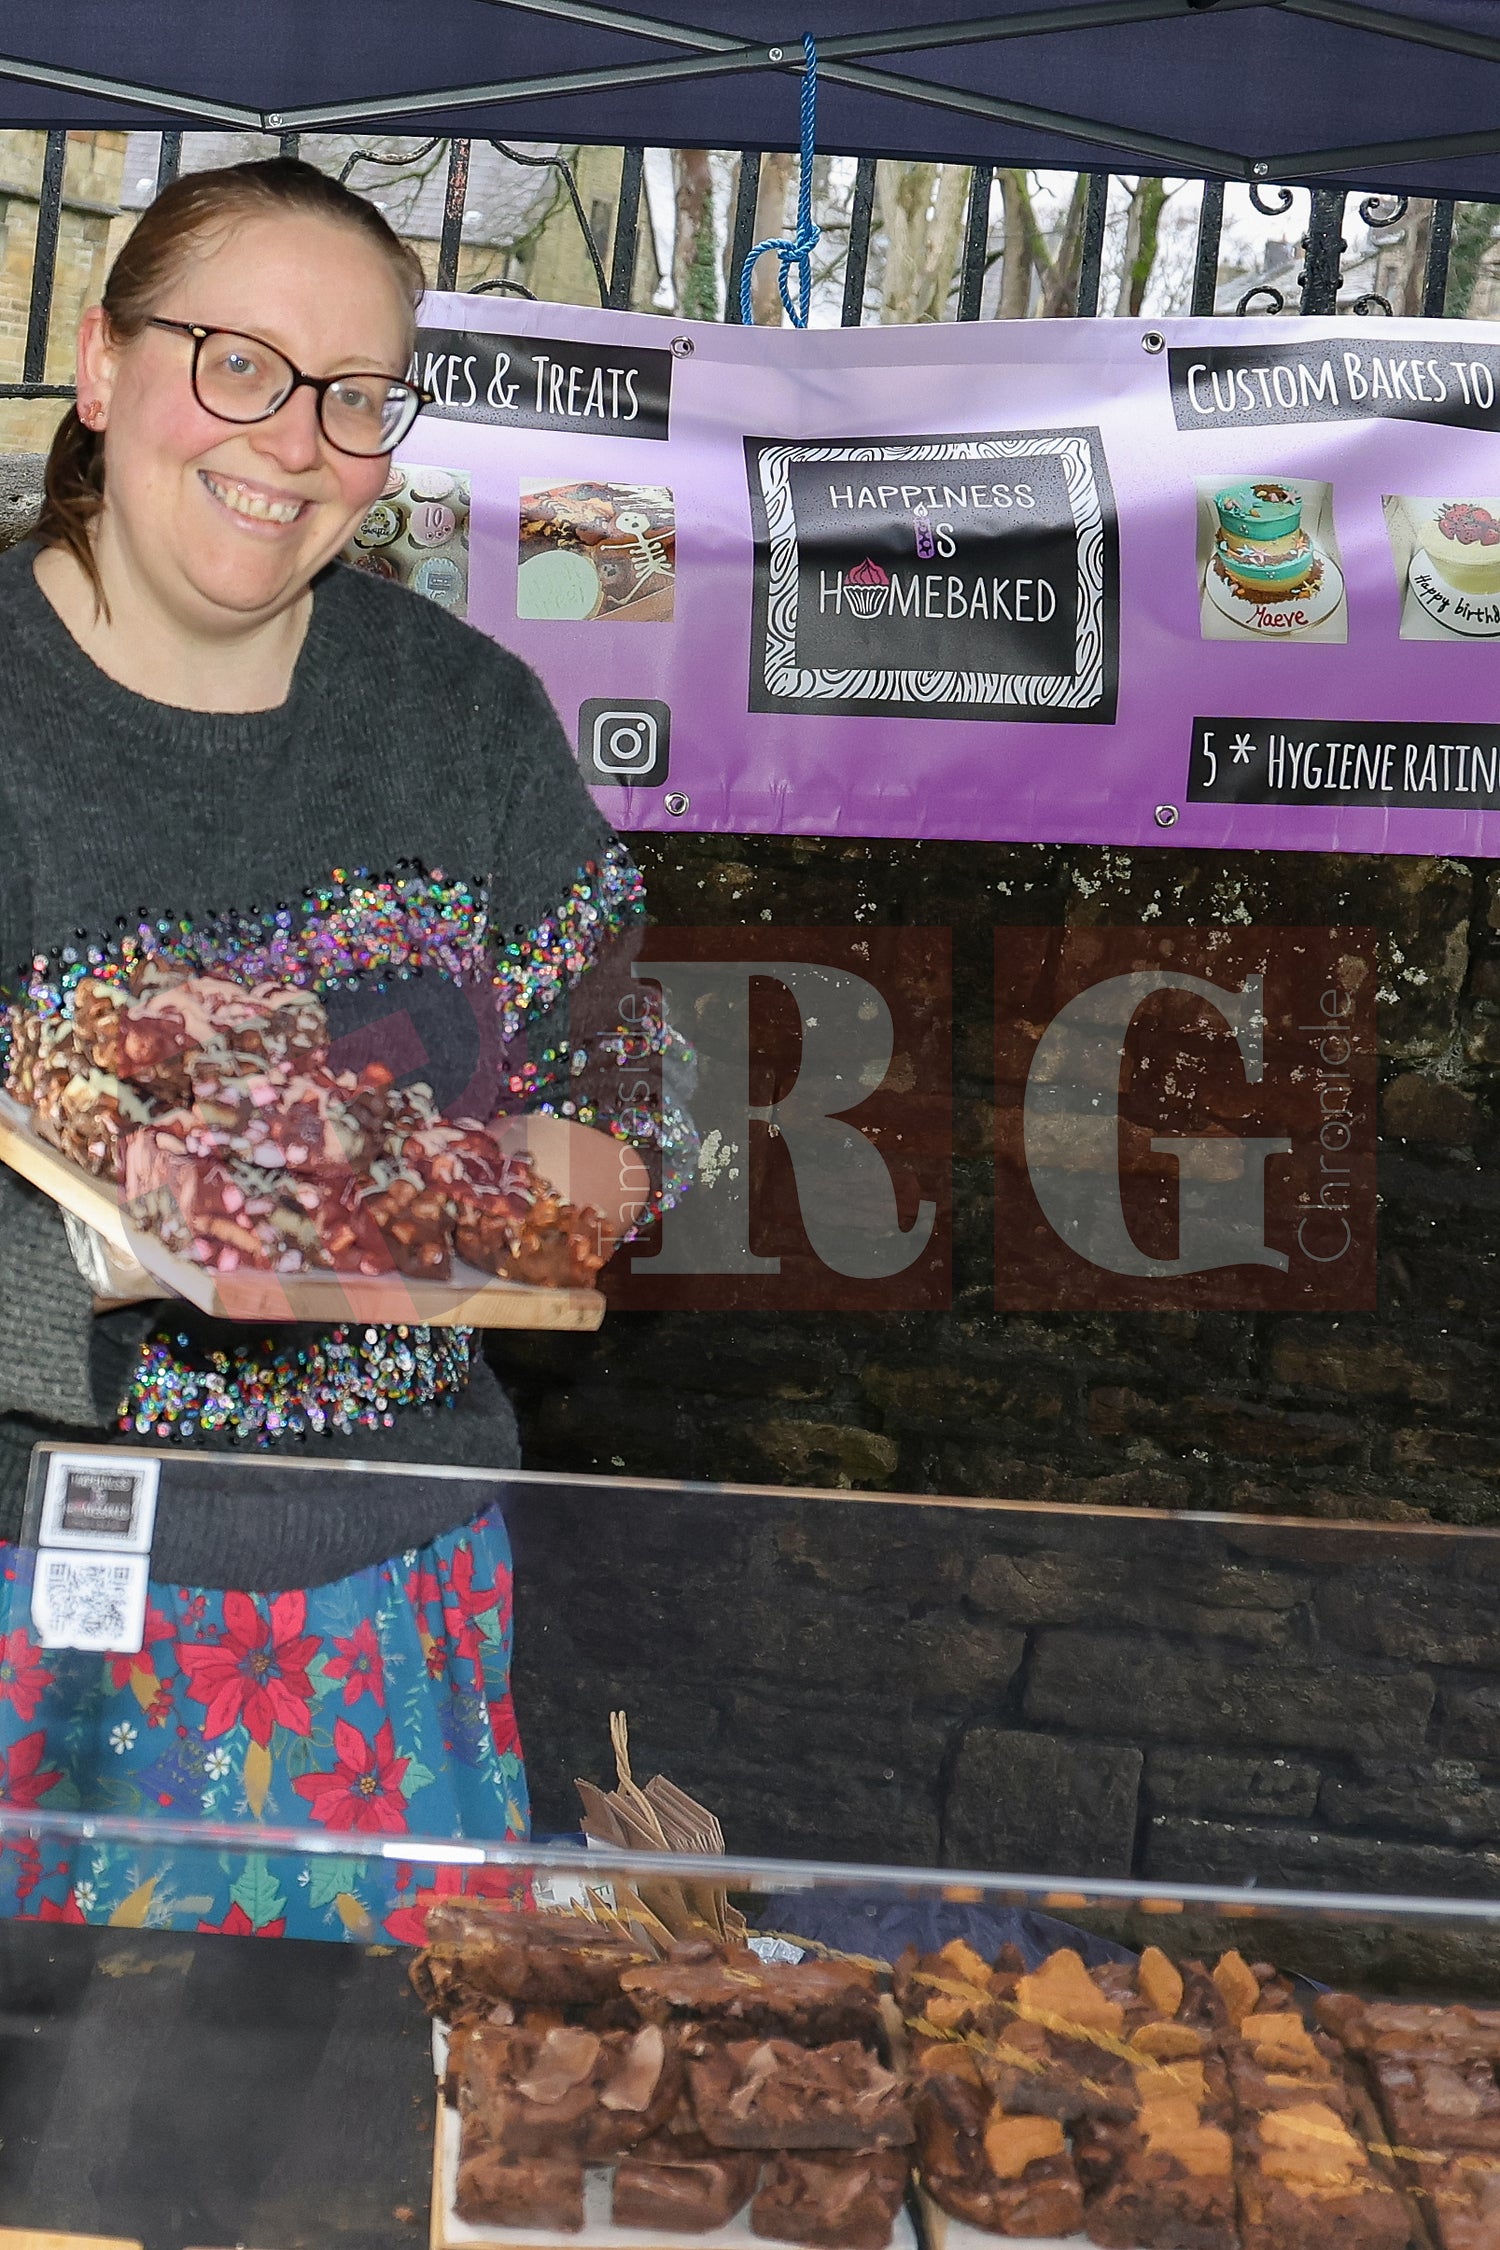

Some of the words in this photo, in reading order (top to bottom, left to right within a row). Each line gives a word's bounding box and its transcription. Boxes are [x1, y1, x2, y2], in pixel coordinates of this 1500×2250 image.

[487, 353, 520, 409] &
[532, 356, 639, 421] TREATS
[1187, 359, 1339, 414] CUSTOM
[1343, 352, 1447, 403] BAKES
[1450, 361, 1494, 409] TO
[829, 485, 1036, 508] HAPPINESS
[426, 507, 443, 528] 10
[1414, 574, 1450, 613] Happy
[1247, 606, 1309, 628] Maeve
[1202, 732, 1217, 787] 5
[1268, 734, 1397, 791] HYGIENE
[1403, 743, 1500, 793] RATIN
